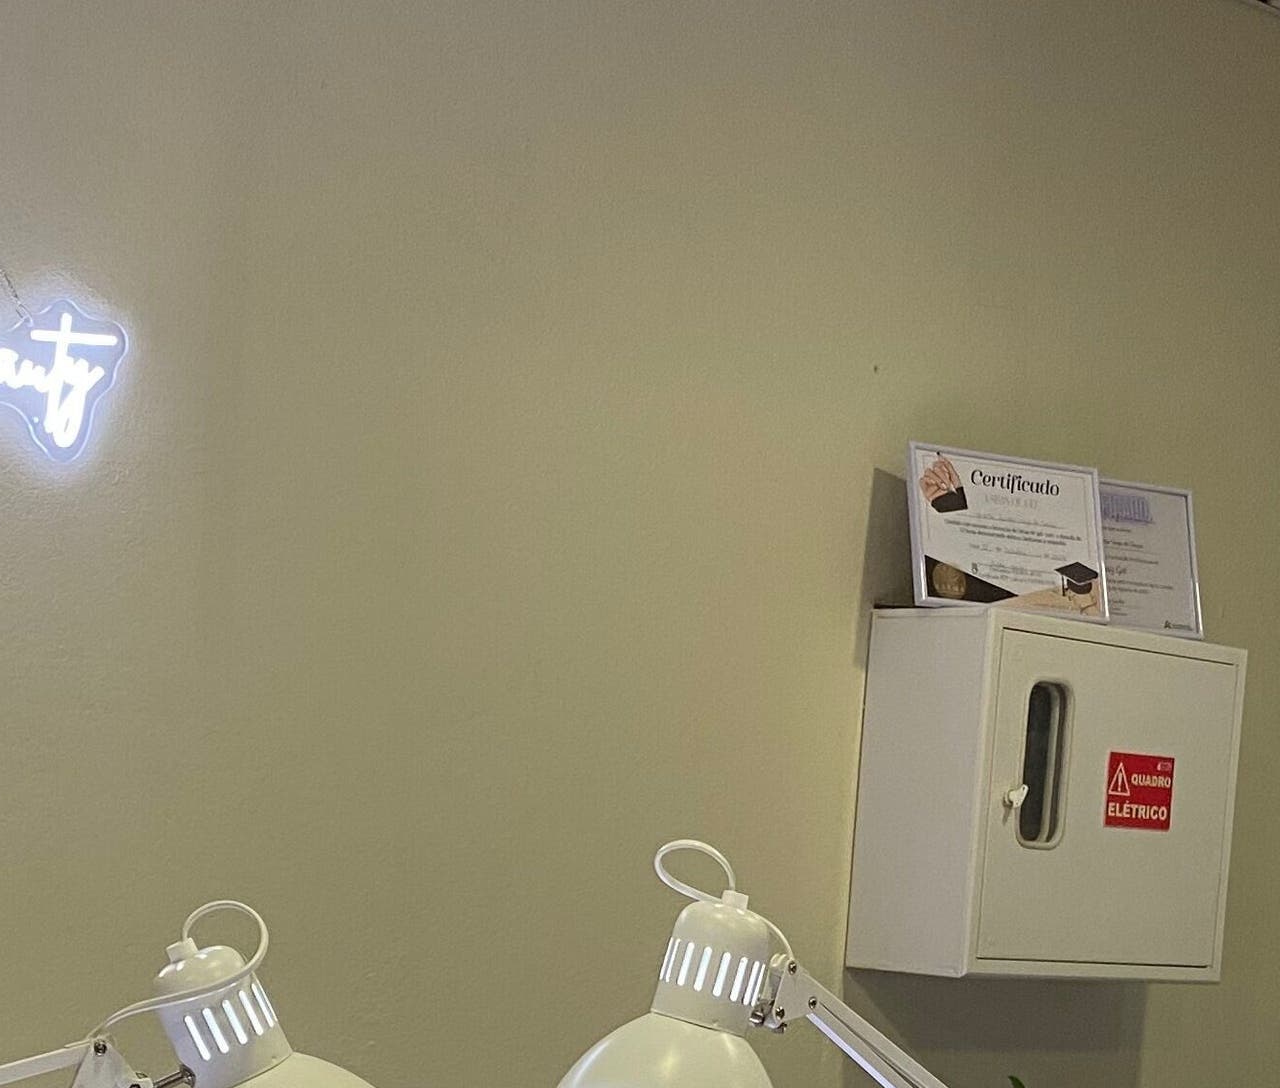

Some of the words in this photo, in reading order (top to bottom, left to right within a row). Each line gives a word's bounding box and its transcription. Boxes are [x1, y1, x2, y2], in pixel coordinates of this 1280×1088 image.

[971, 469, 1059, 496] Certificado
[1131, 774, 1171, 788] QUADRO
[1108, 800, 1168, 820] ELÉTRICO
